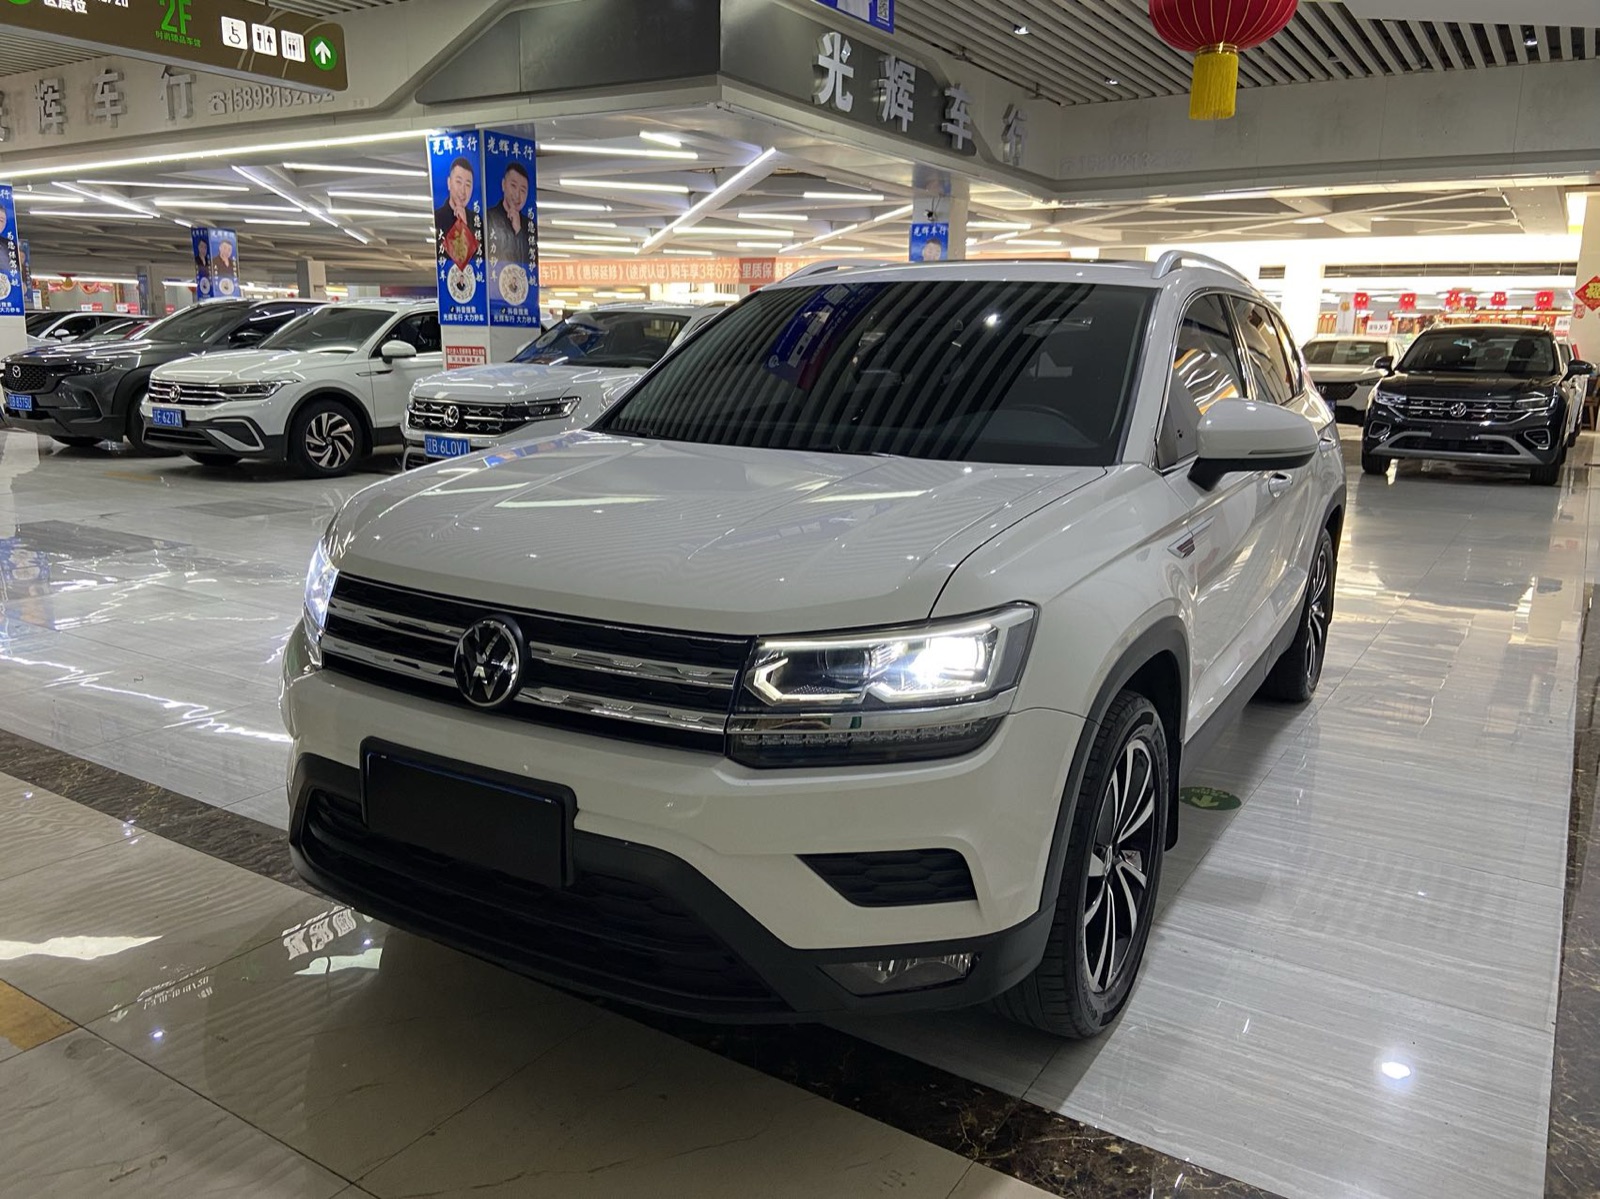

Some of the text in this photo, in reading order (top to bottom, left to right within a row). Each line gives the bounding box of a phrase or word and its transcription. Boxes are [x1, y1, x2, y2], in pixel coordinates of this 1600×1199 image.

[160, 0, 192, 35] 2F
[812, 31, 1029, 166] 光辉车行
